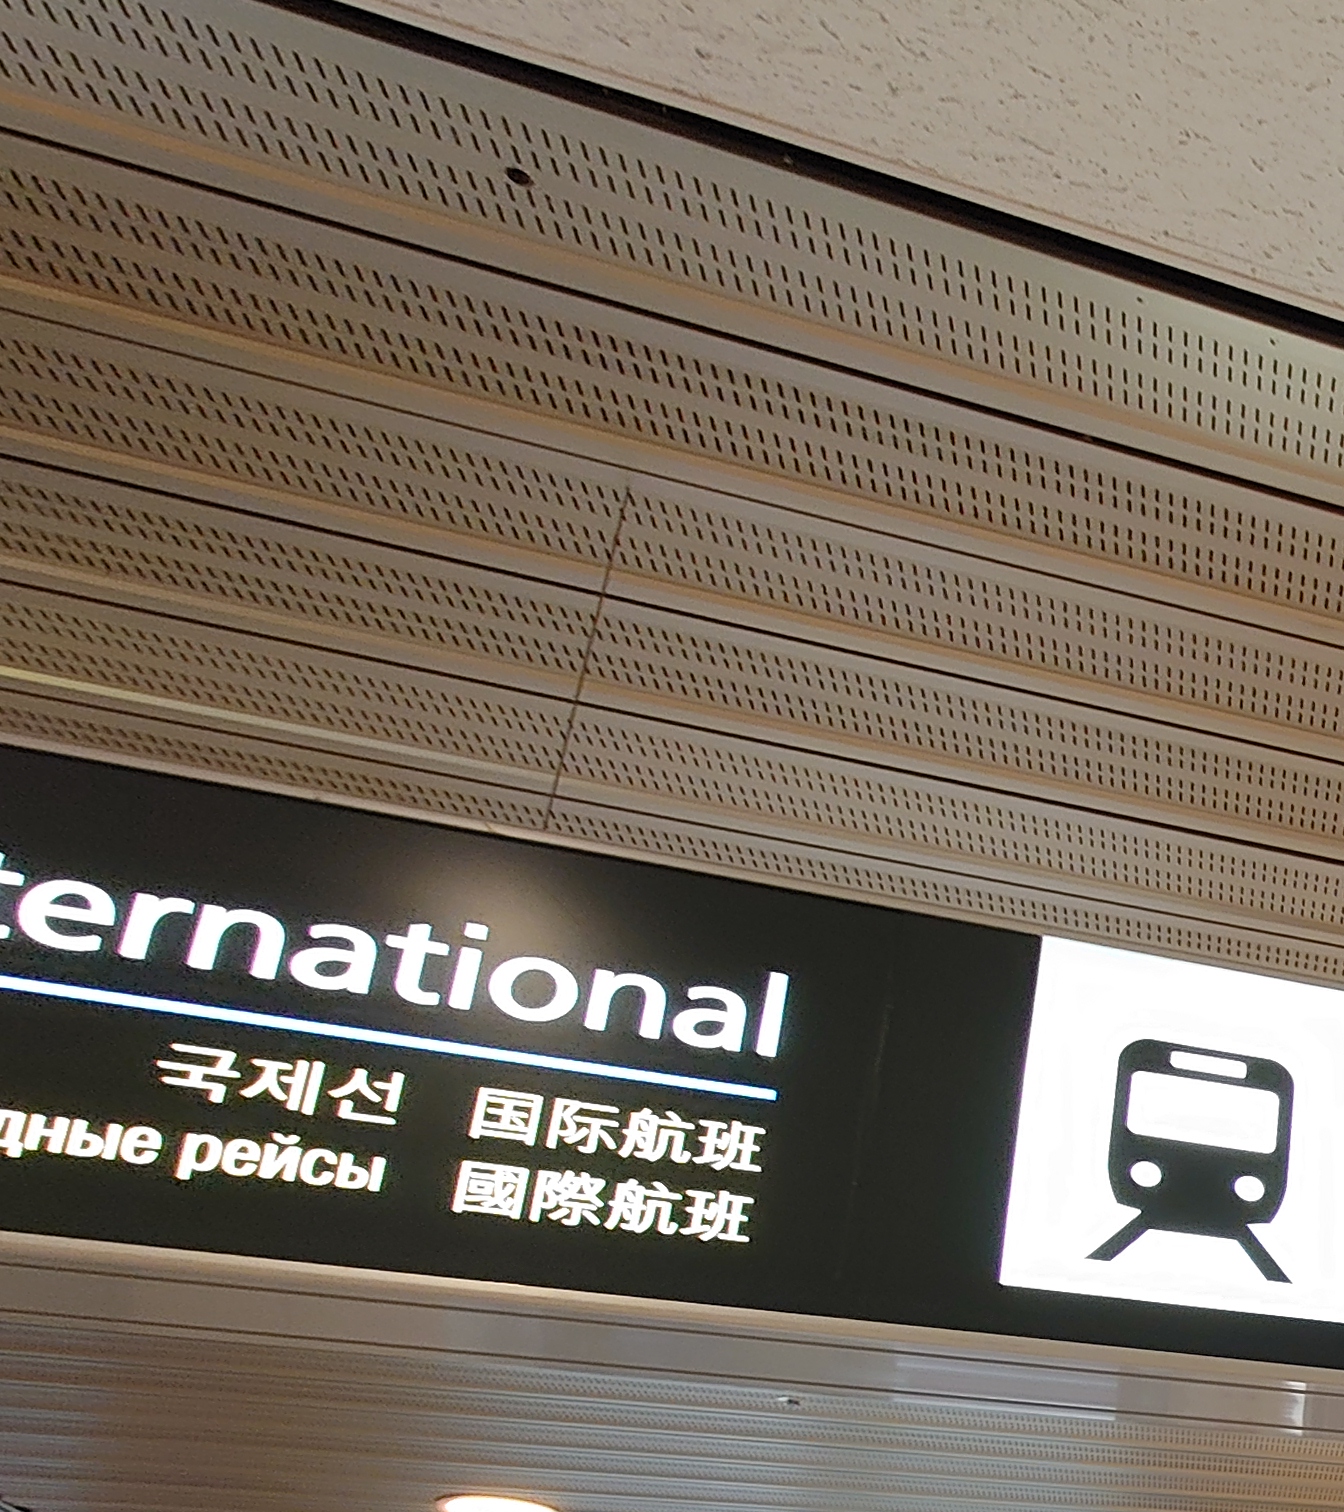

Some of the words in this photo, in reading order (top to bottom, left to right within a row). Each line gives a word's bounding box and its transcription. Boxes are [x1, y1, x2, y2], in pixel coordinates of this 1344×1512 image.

[154, 1041, 406, 1126] 국제선
[173, 1131, 388, 1193] рейсы
[467, 1085, 767, 1173] 国际航班
[449, 1158, 756, 1243] 國際航班
